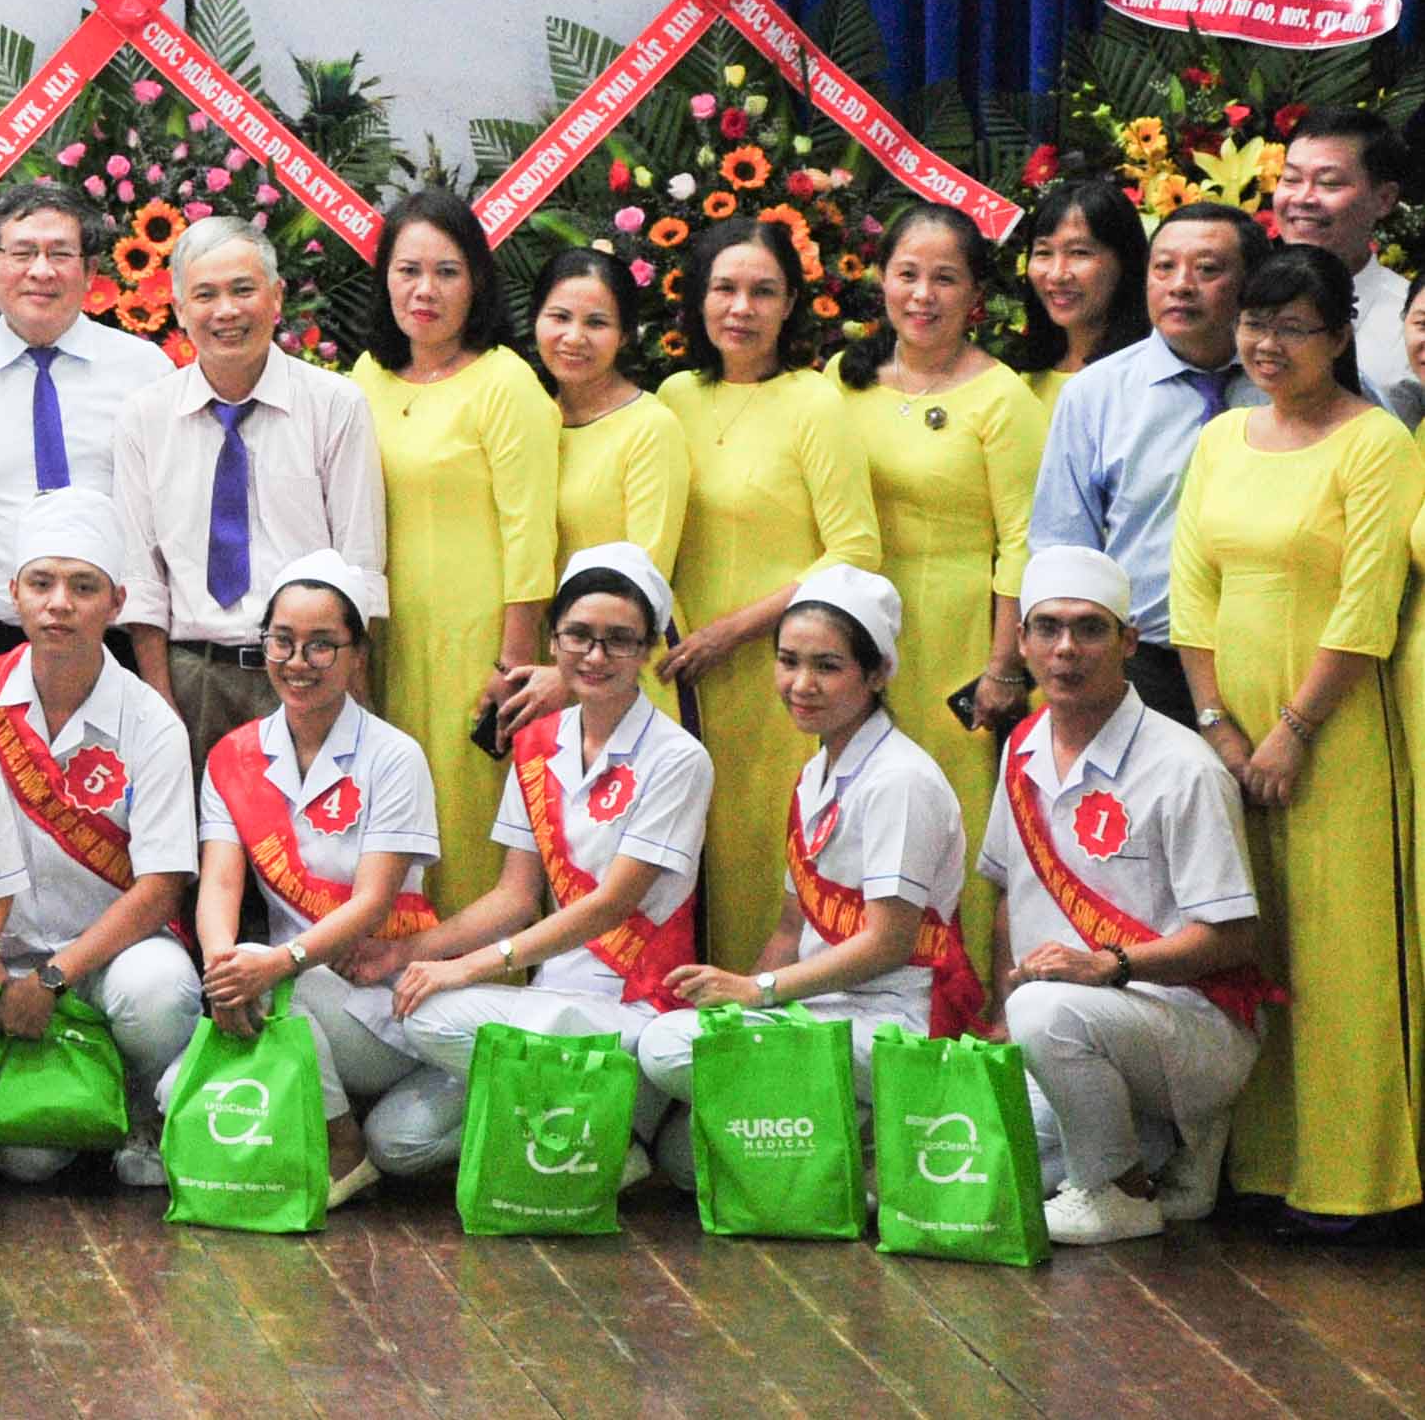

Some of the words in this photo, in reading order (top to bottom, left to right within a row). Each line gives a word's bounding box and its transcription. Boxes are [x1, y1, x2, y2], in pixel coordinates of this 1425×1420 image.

[661, 0, 705, 44] RHM
[1229, 0, 1250, 16] THI
[40, 61, 81, 102] NLN
[138, 17, 189, 67] CHÚC
[211, 87, 247, 123] HỘI
[83, 764, 113, 794] 5
[323, 787, 341, 818] 4
[600, 780, 621, 809] 3
[1091, 810, 1110, 842] 1
[743, 1117, 814, 1138] URGO
[744, 1140, 816, 1148] MEDICAL
